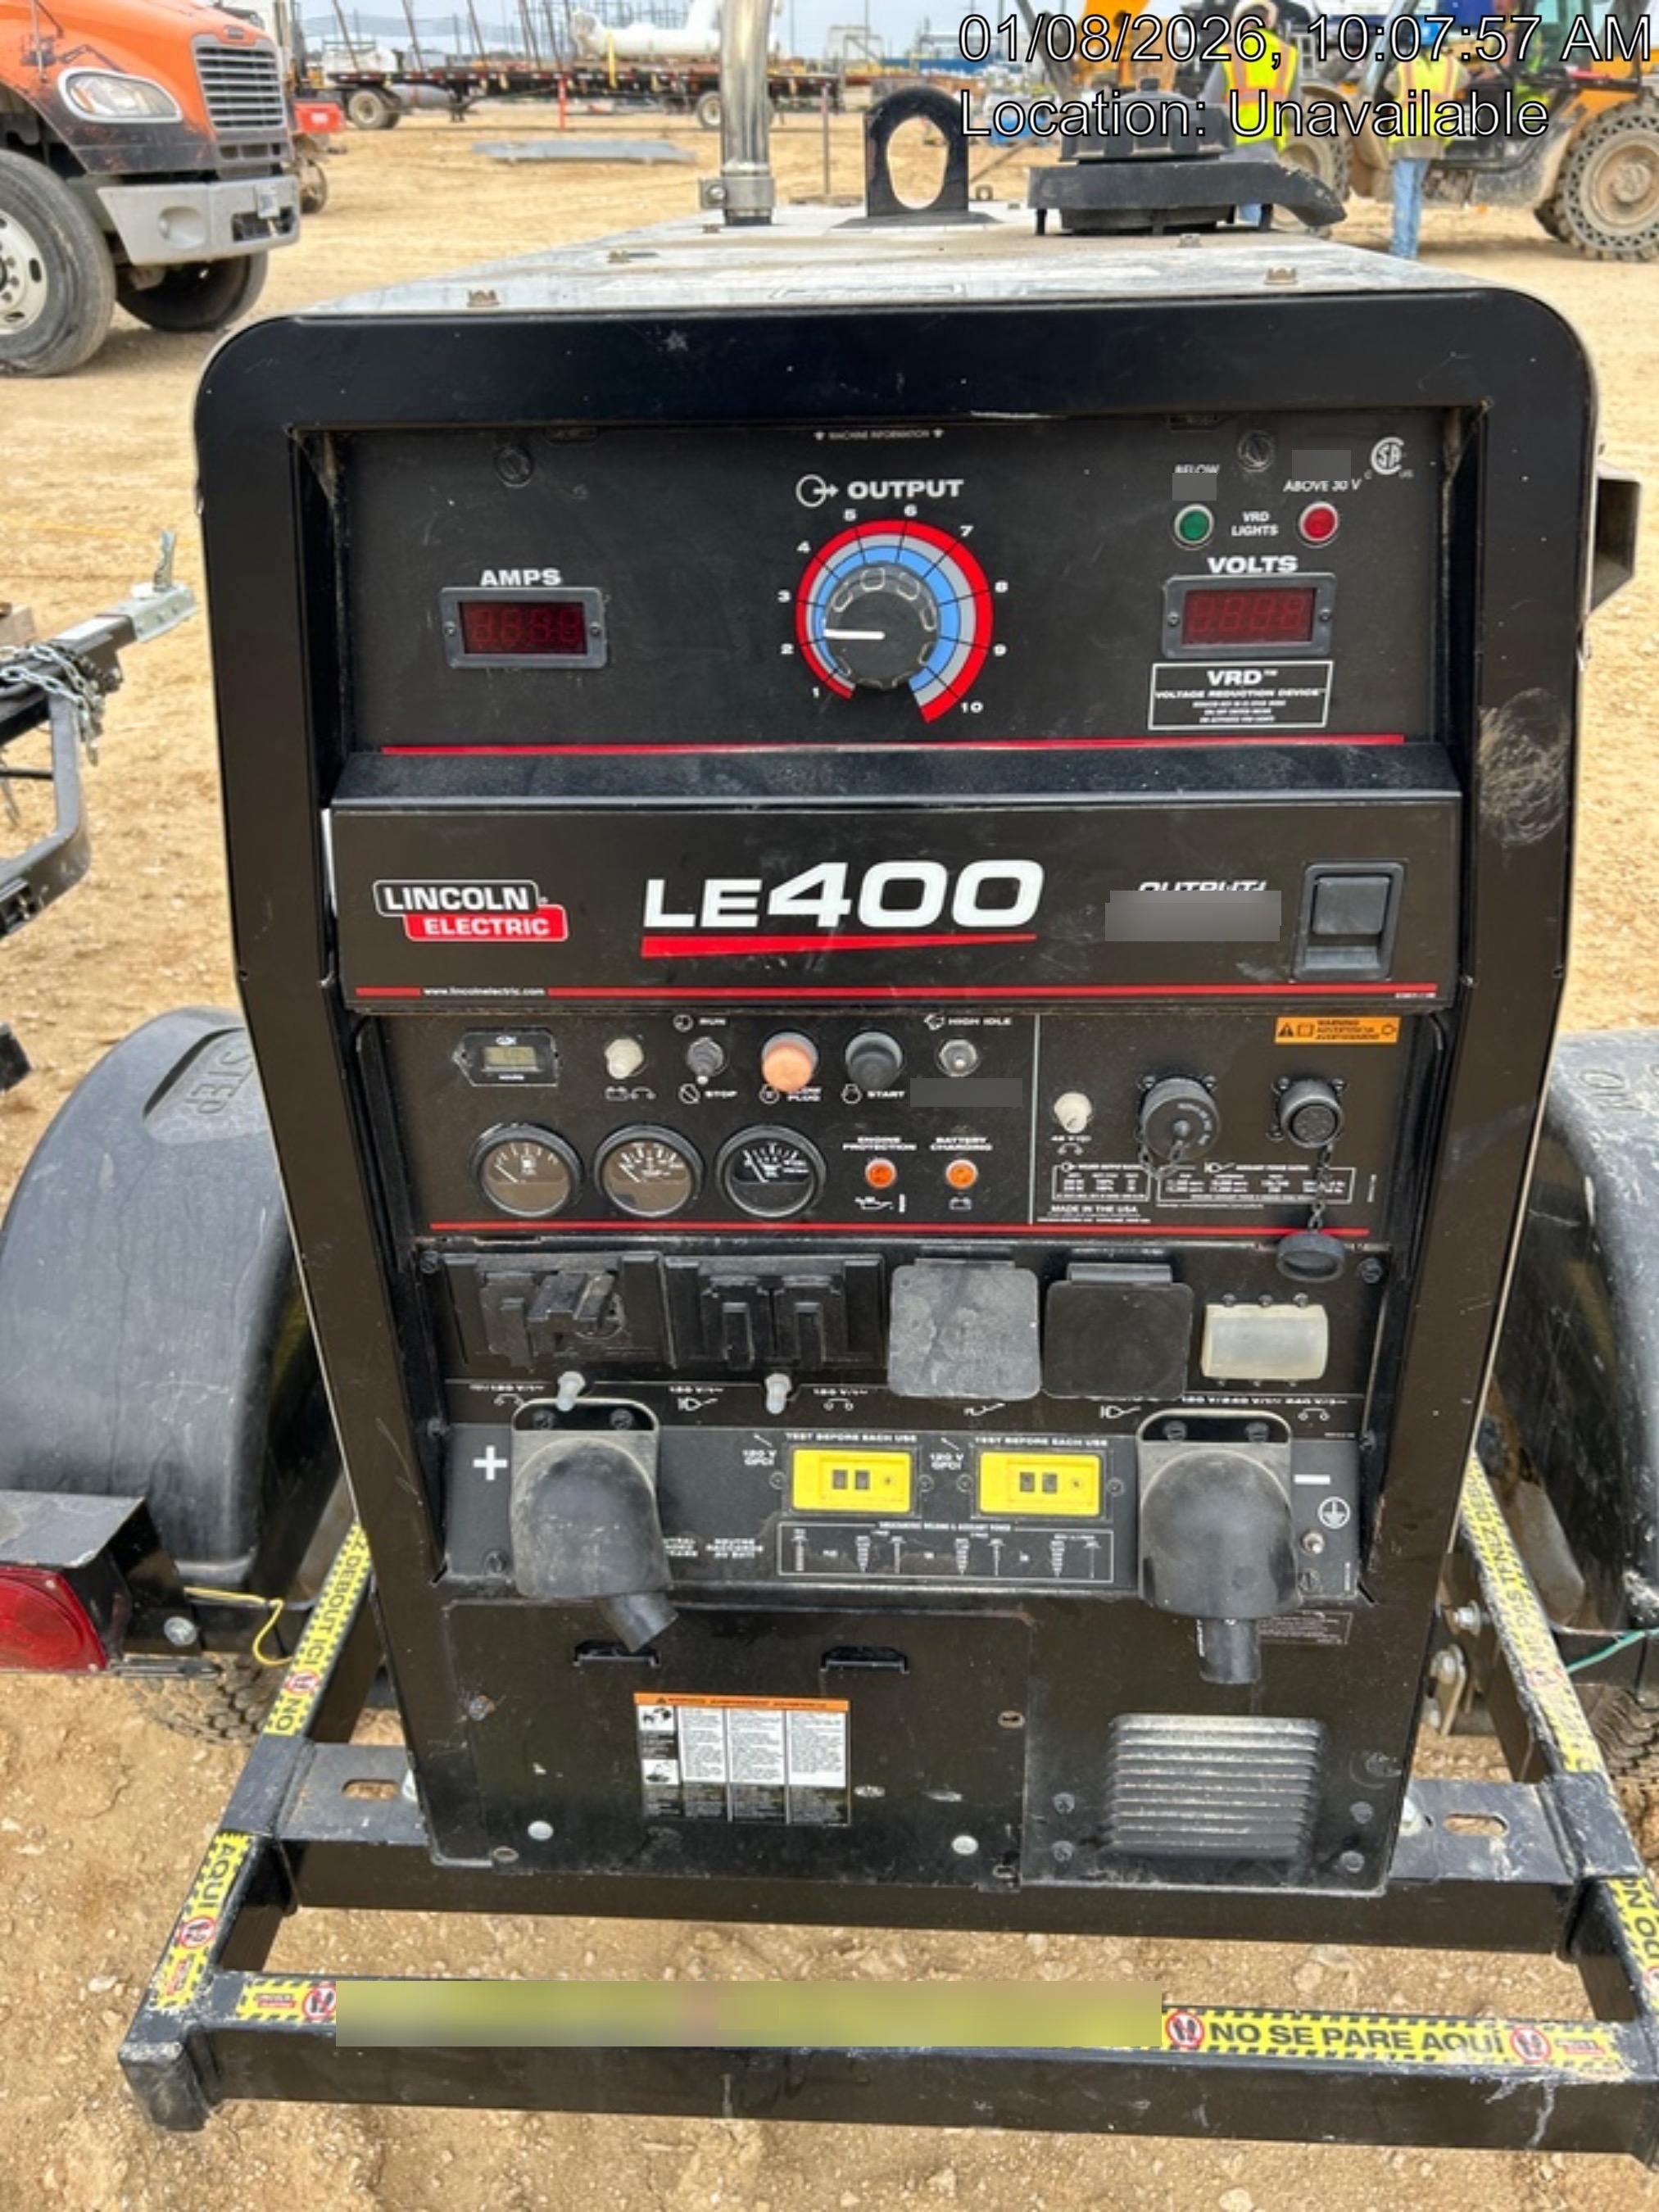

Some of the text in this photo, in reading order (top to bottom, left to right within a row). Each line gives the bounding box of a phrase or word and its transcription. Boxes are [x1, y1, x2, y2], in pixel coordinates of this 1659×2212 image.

[846, 479, 964, 500] OUTPUT
[1282, 480, 1329, 492] ABOVE
[844, 509, 857, 521] 5
[904, 505, 918, 517] 6
[1242, 512, 1270, 522] VRD
[960, 525, 974, 537] 7
[1231, 525, 1279, 537] LIGHTS
[796, 541, 811, 553] 4
[1207, 556, 1298, 574] VOLTS
[480, 569, 562, 587] AMPS
[995, 581, 1009, 593] 8
[778, 590, 791, 602] 3
[781, 643, 794, 655] 2
[993, 643, 1007, 656] 9
[812, 687, 819, 697] 1
[960, 700, 983, 713] 10
[383, 887, 528, 910] LINCOLN
[643, 859, 1045, 928] LE400
[423, 918, 550, 936] ELECTRIC
[423, 987, 546, 997] www.lincolnelectric.com
[862, 1434, 892, 1442] EACH
[1052, 1438, 1082, 1446] EACH
[317, 1555, 361, 1633] DEBOUT
[275, 1697, 301, 1730] NO
[1208, 2022, 1260, 2043] NO
[1270, 2024, 1315, 2046] SE
[1321, 2028, 1413, 2050] PARE
